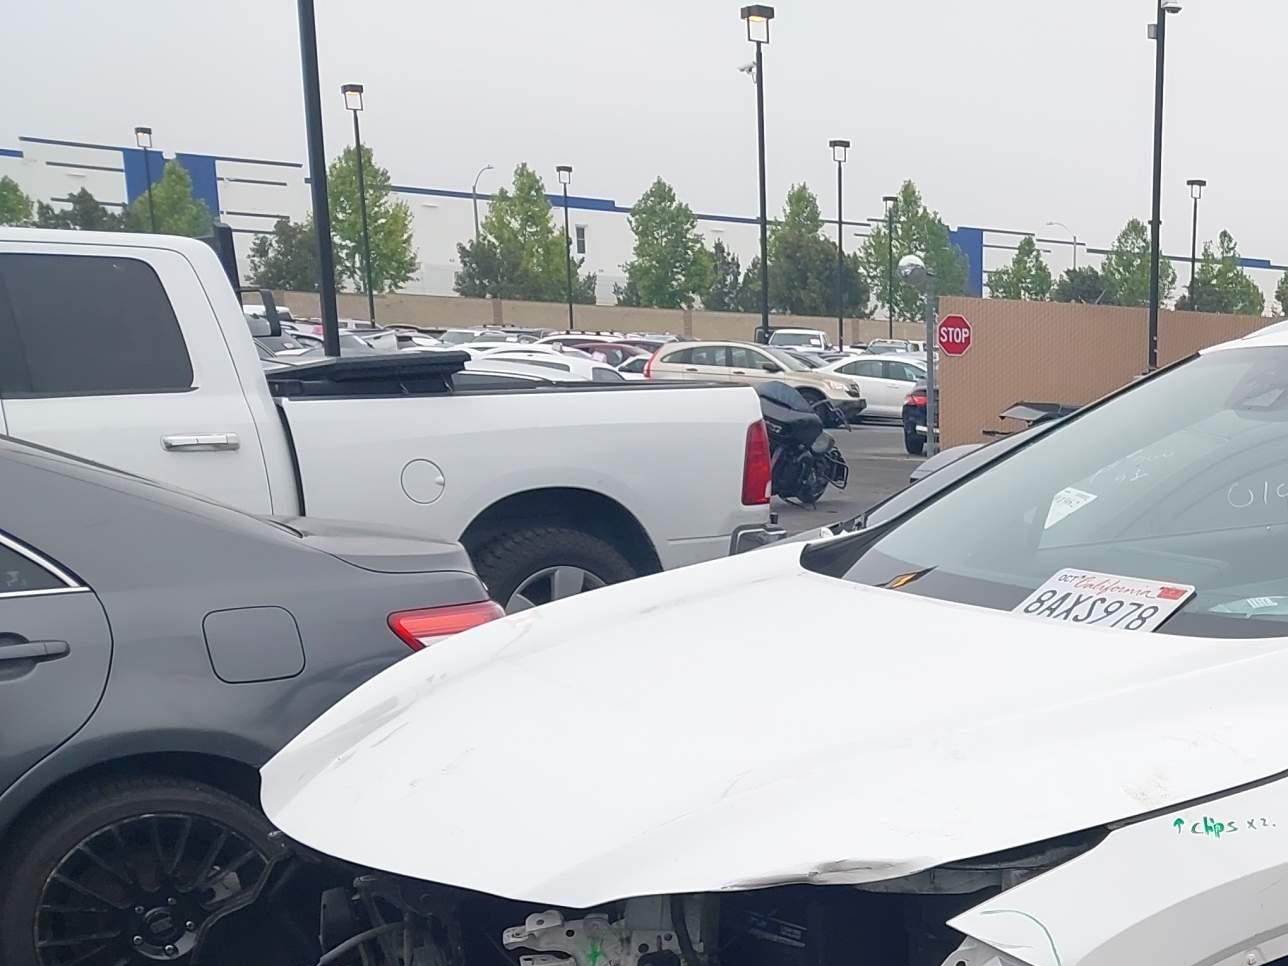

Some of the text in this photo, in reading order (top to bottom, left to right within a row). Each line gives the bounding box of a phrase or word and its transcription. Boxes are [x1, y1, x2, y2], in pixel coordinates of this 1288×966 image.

[940, 327, 970, 343] STOP
[1073, 576, 1156, 599] California
[1023, 590, 1159, 630] 8AXS978
